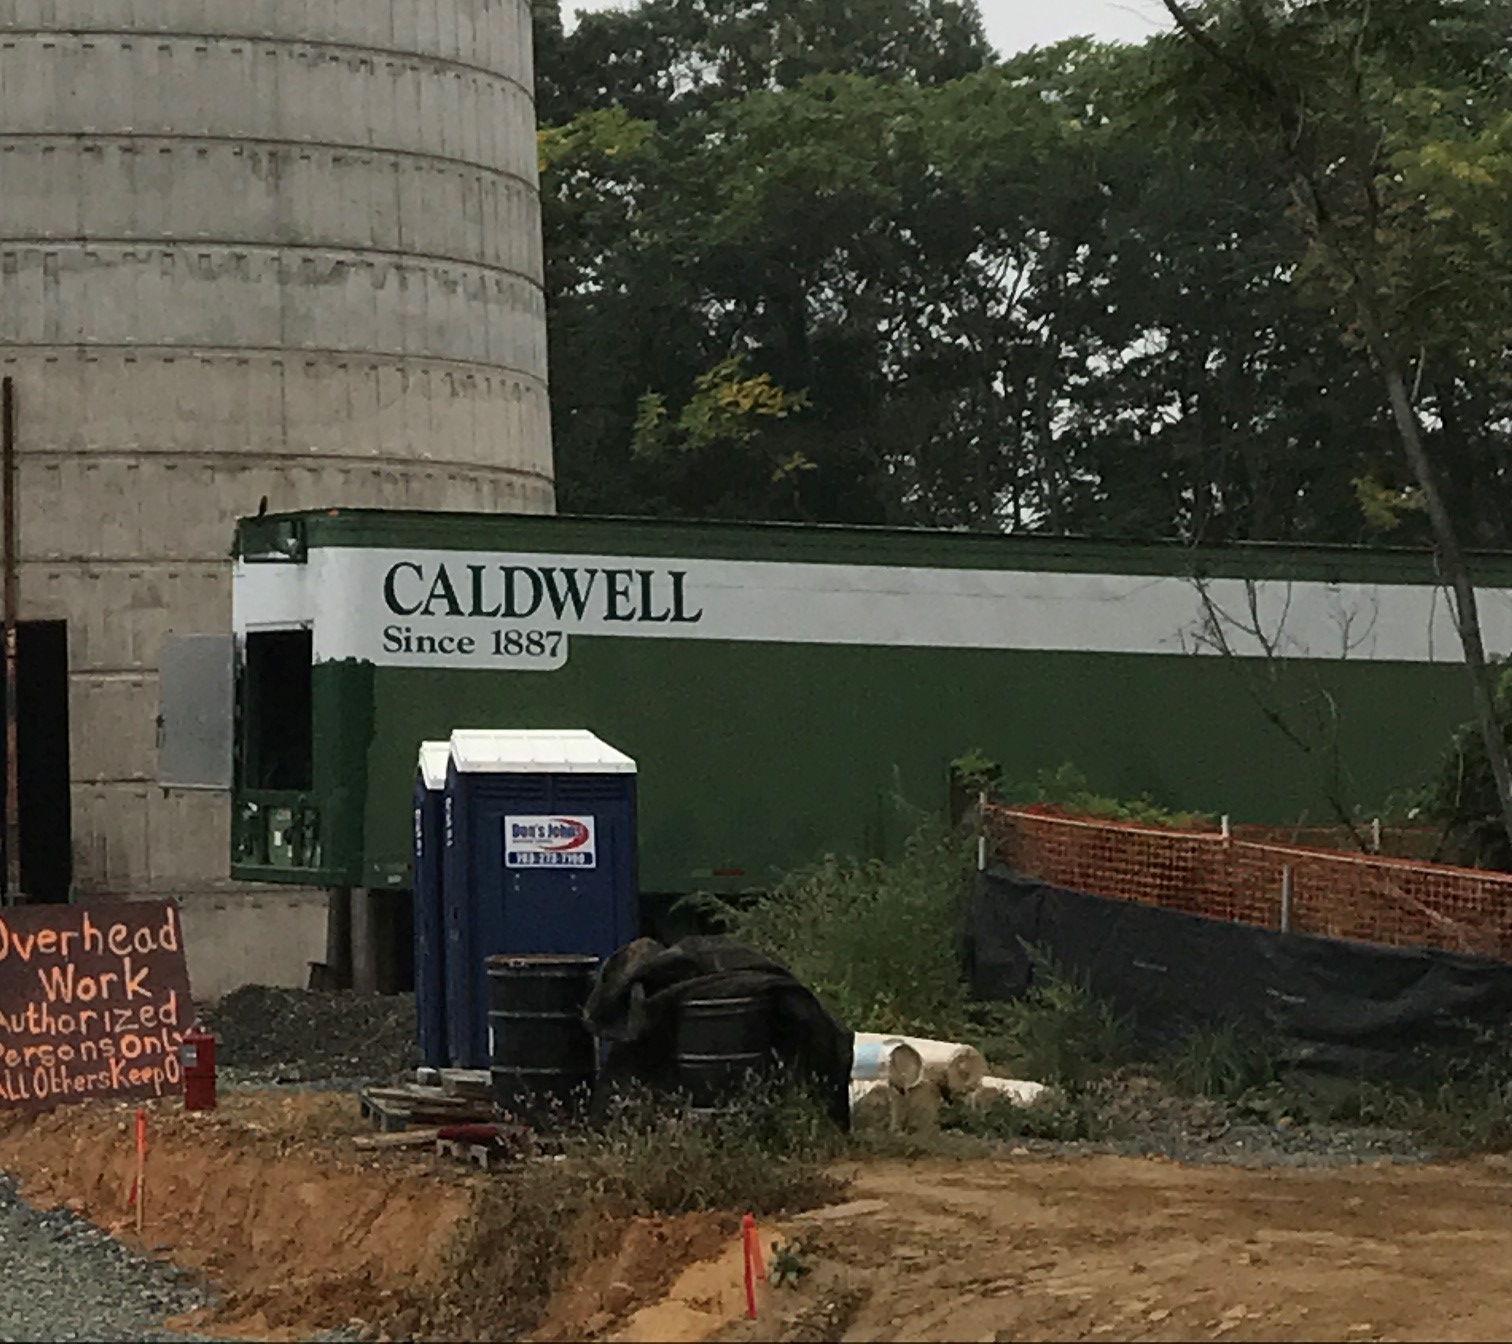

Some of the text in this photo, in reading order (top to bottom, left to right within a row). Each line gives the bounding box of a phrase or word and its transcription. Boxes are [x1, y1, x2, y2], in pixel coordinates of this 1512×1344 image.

[383, 561, 703, 623] CALDWELL
[383, 625, 563, 658] Since 1887
[39, 957, 152, 1003] Work
[33, 1066, 110, 1099] Others
[109, 1057, 165, 1096] Keep
